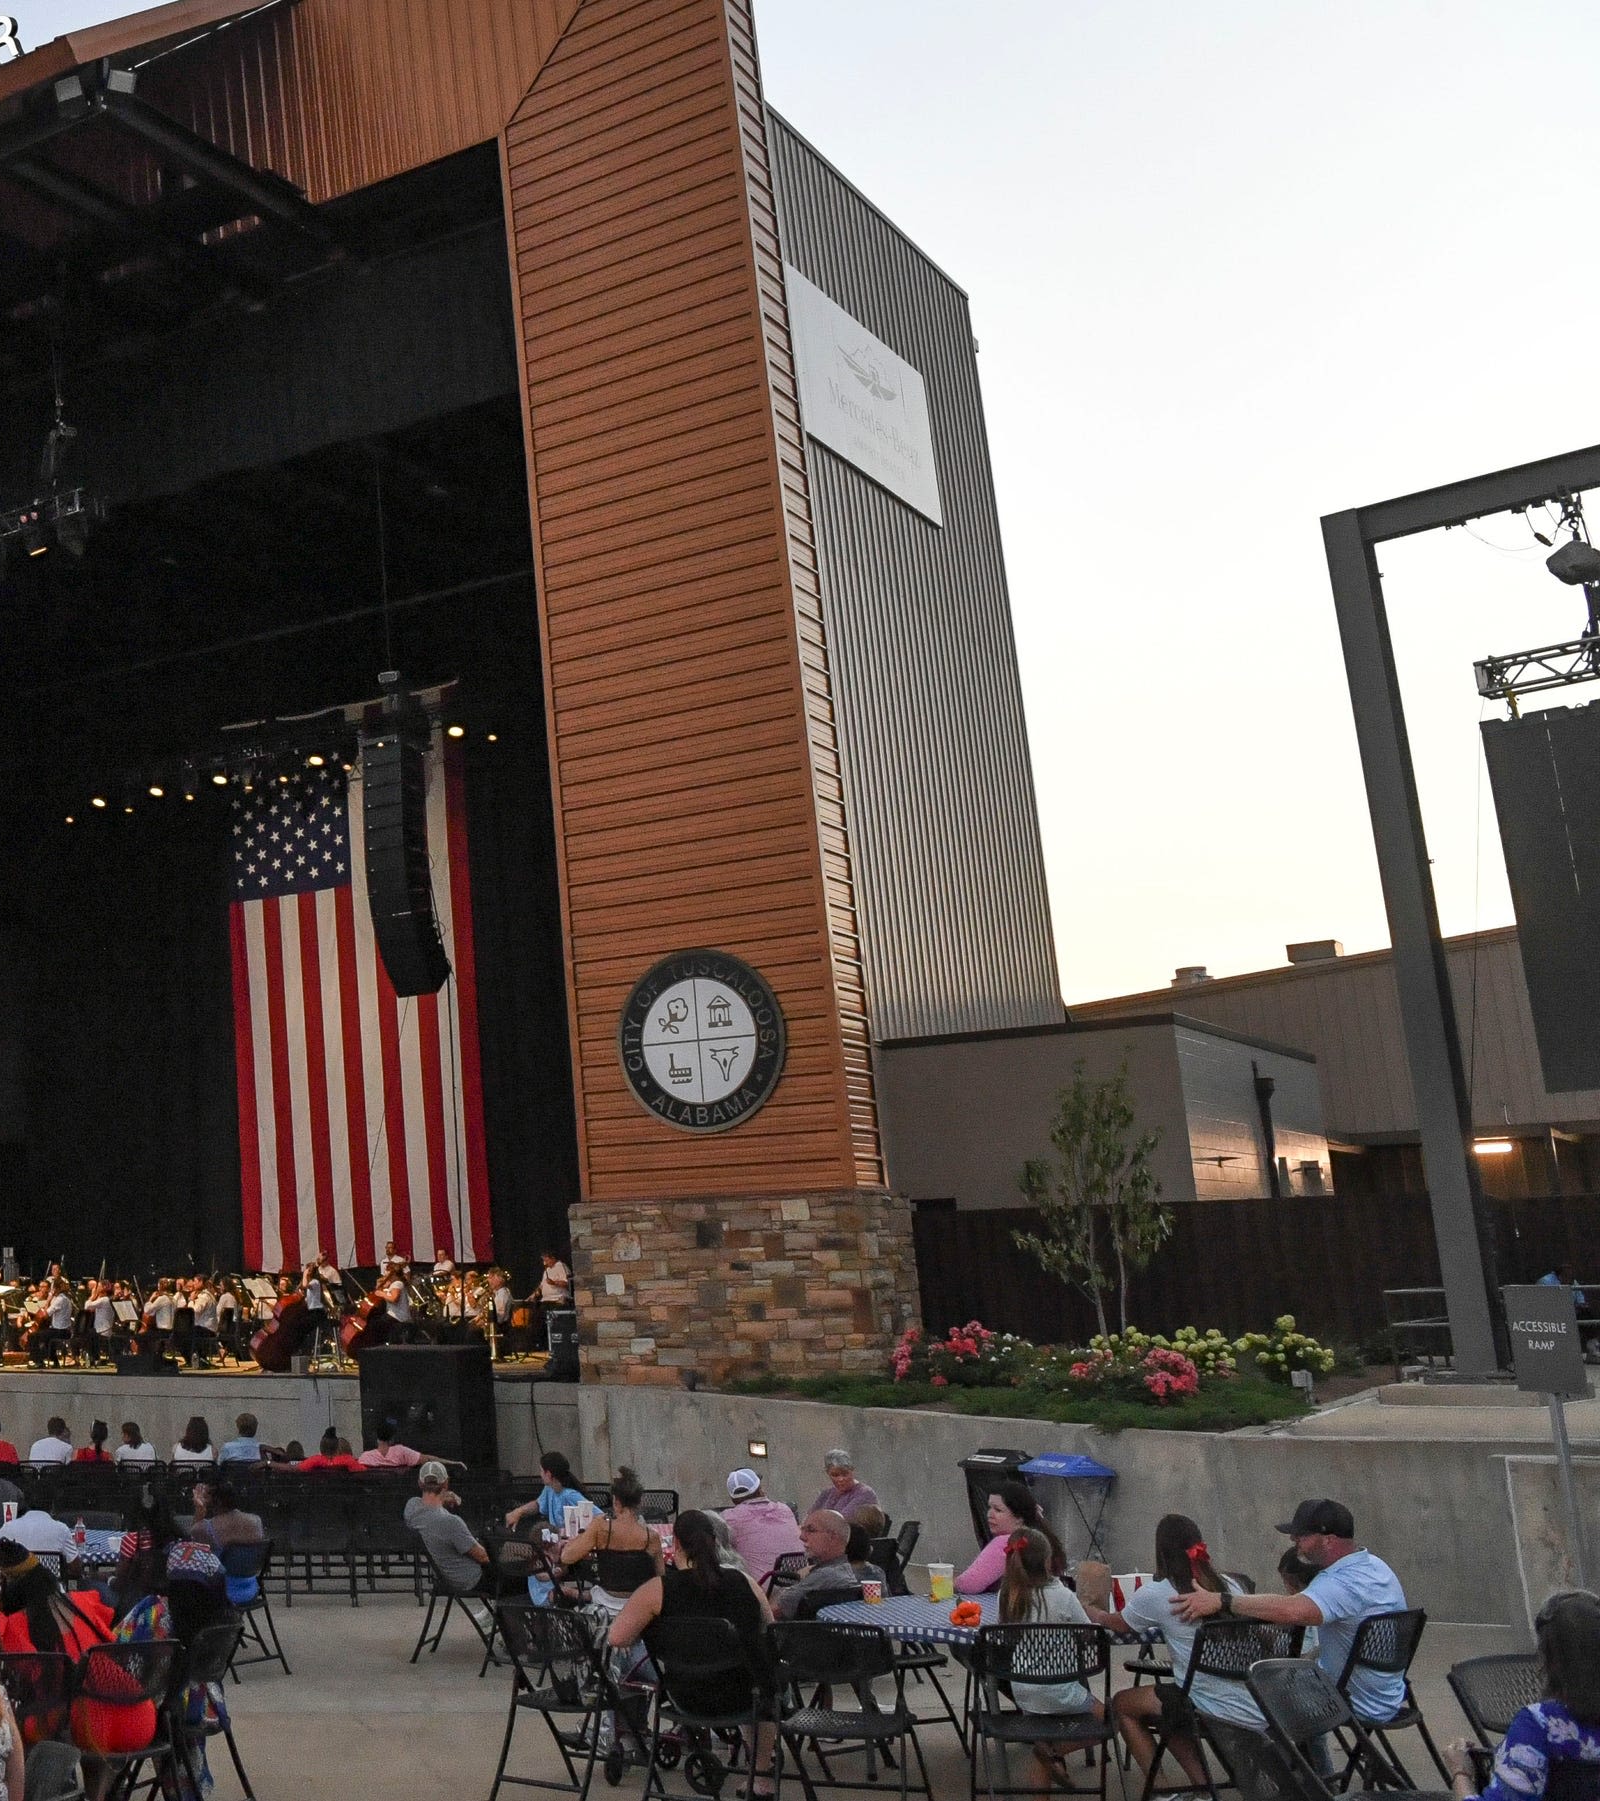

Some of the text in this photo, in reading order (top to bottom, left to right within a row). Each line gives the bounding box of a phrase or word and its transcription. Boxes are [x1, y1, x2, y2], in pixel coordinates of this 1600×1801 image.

[827, 376, 921, 469] Mercedes-Benz
[625, 957, 777, 1072] CITY OF TUSCALOOSA
[651, 1087, 758, 1125] ALABAMA
[1512, 1321, 1567, 1333] ACCESSIBLE
[1527, 1340, 1555, 1350] RAMP
